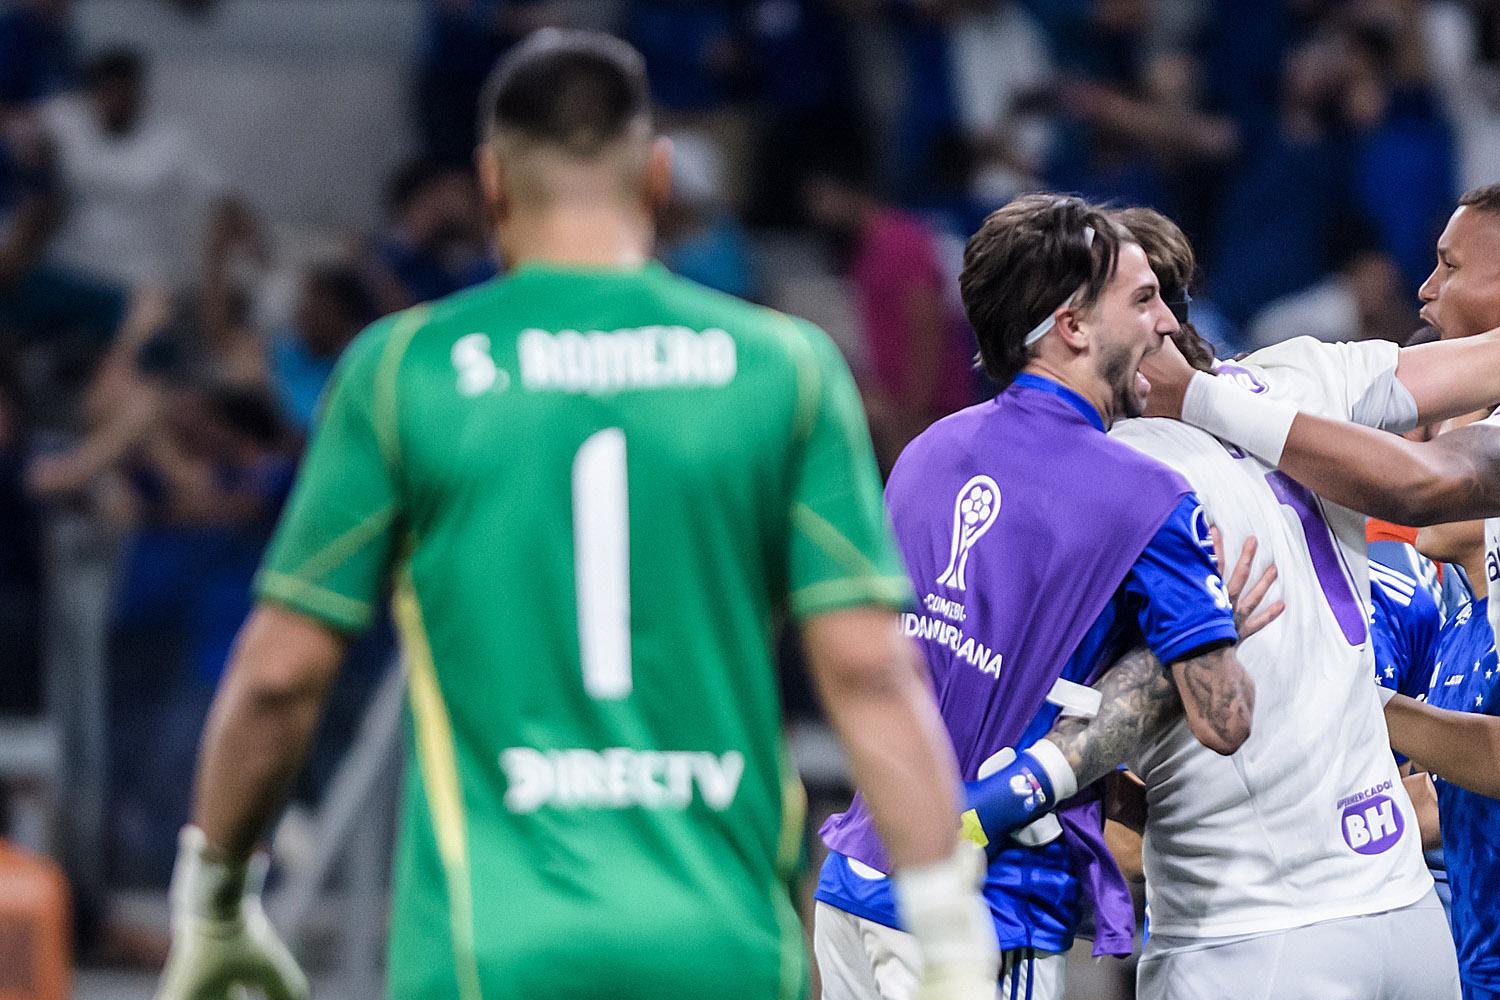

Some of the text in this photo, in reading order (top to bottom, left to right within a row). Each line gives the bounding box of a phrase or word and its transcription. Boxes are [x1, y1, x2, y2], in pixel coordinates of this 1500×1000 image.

[450, 325, 738, 398] S. ROMERO
[571, 426, 633, 701] 1
[497, 746, 745, 815] DIRECTV
[1345, 799, 1398, 849] BH
